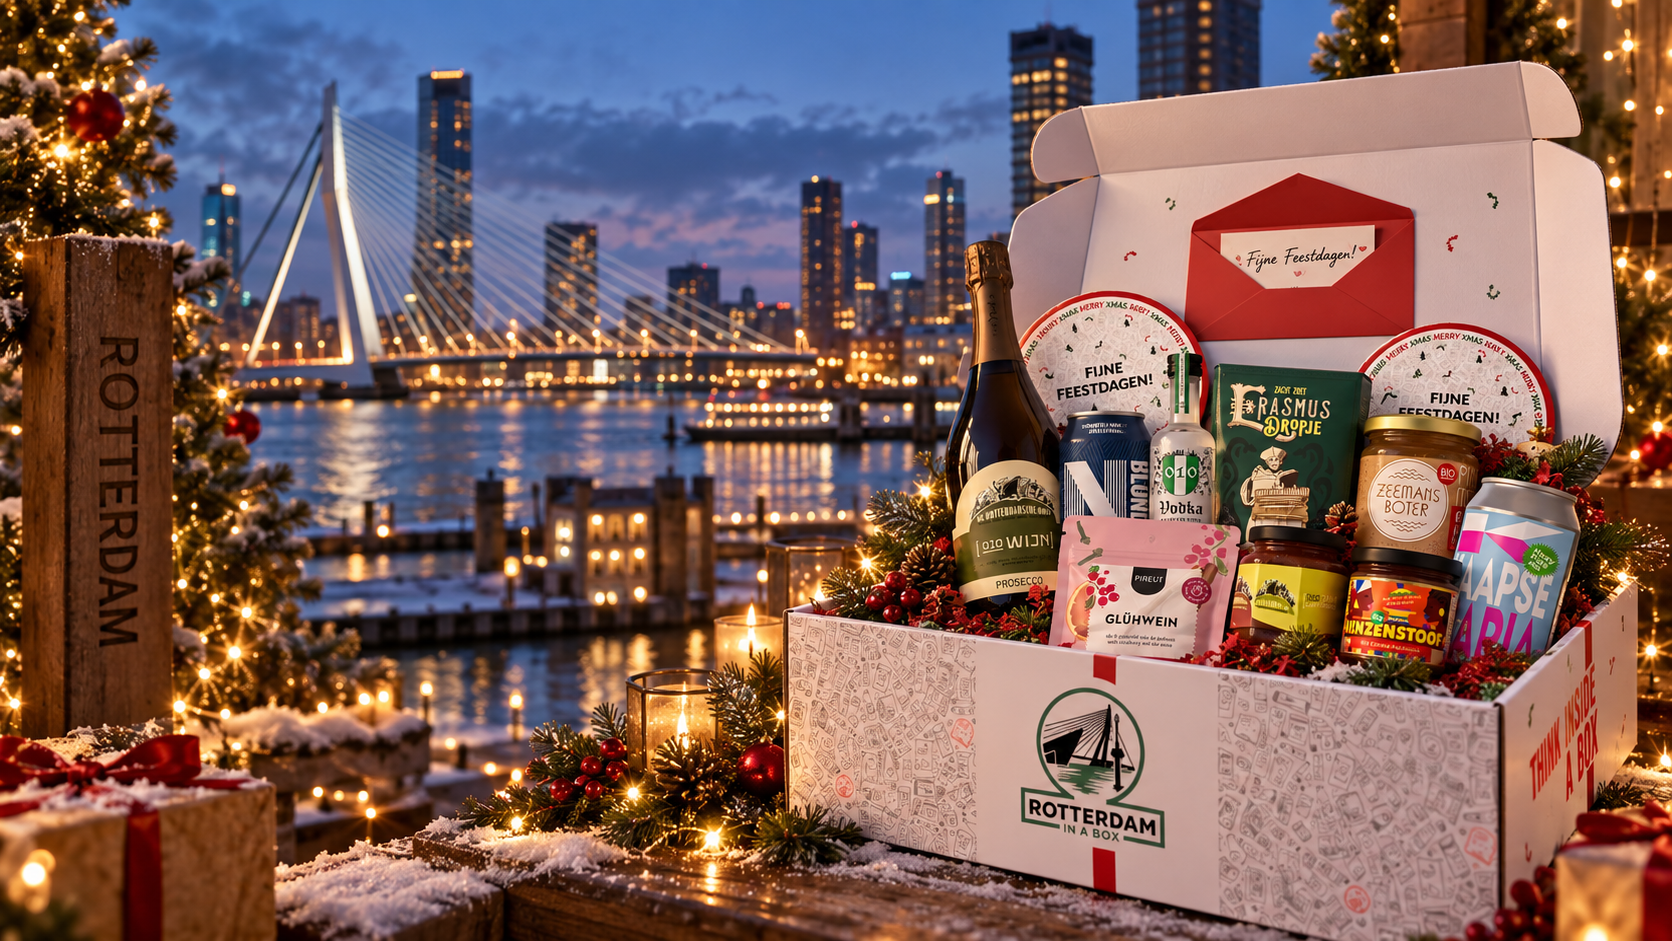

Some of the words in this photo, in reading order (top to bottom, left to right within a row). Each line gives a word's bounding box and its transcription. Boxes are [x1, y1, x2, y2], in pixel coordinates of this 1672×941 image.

[1247, 249, 1278, 273] Fijne
[1284, 244, 1358, 268] Feestdagen!
[1433, 332, 1461, 341] MERRY
[1461, 334, 1484, 345] XMAS
[1084, 362, 1124, 379] FIJNE
[1056, 373, 1154, 401] FEESTDAGEN!
[1227, 382, 1331, 433] ERASMUS
[1430, 392, 1470, 406] FIJNE
[1263, 416, 1322, 438] DROPJE
[1164, 466, 1197, 480] 010
[1440, 467, 1456, 479] BIO
[99, 337, 139, 648] ROTTERDAM
[1063, 460, 1127, 519] N
[1130, 460, 1149, 519] BLON
[1376, 483, 1441, 503] ZEEMANS
[1159, 500, 1203, 515] Vodka
[1384, 500, 1429, 517] BOTER
[996, 576, 1043, 589] PROSECCO
[1134, 575, 1163, 583] PIREUT
[1105, 612, 1178, 627] GLÜHWEIN
[1529, 716, 1562, 801] THINK
[1564, 663, 1596, 748] INSIDE
[1566, 750, 1573, 802] A
[1577, 708, 1599, 782] BOX
[1029, 798, 1156, 836] ROTTERDAM
[1063, 823, 1076, 835] IN
[1080, 826, 1088, 837] A
[1092, 828, 1120, 842] BOX
